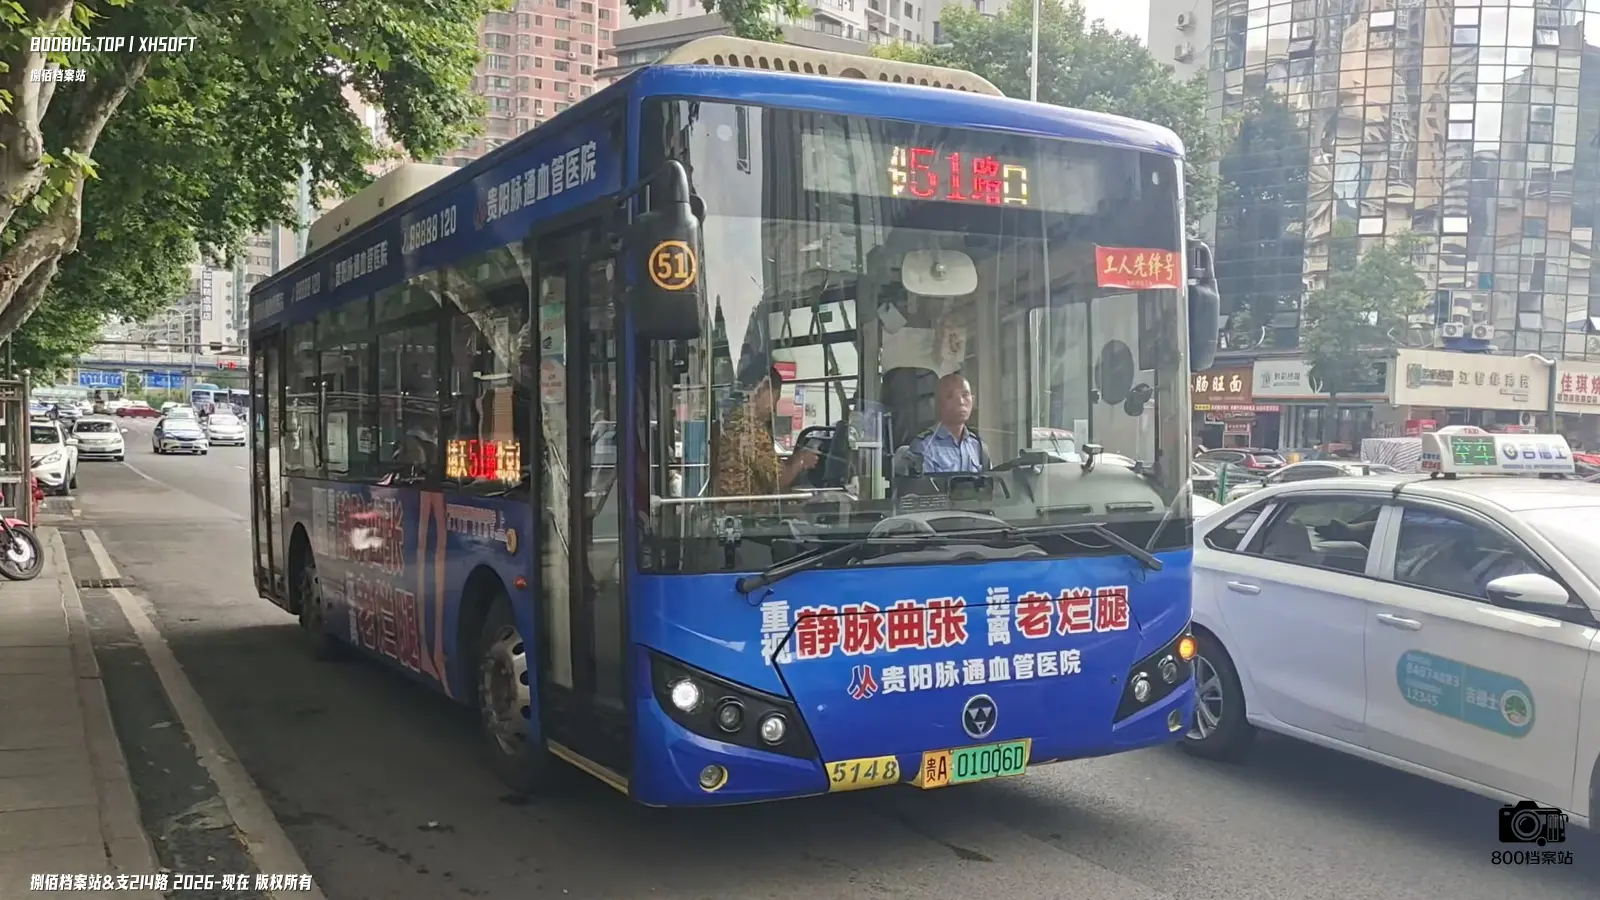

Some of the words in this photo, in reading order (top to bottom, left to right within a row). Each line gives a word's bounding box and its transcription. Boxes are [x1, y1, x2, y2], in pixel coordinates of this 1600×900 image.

[486, 140, 597, 222] 贵阳脉通血管医院
[440, 204, 457, 238] 120
[657, 252, 689, 279] 51
[1103, 252, 1175, 281] 工人先锋号
[1191, 373, 1243, 394] 肠旺面
[795, 598, 969, 659] 静脉曲张
[986, 586, 1011, 647] 远离
[1015, 585, 1131, 640] 老烂腿
[881, 649, 1082, 695] 贵阳脉通血管医院
[831, 759, 898, 785] 5148
[926, 757, 949, 783] 贵A
[956, 747, 1025, 779] 01006D
